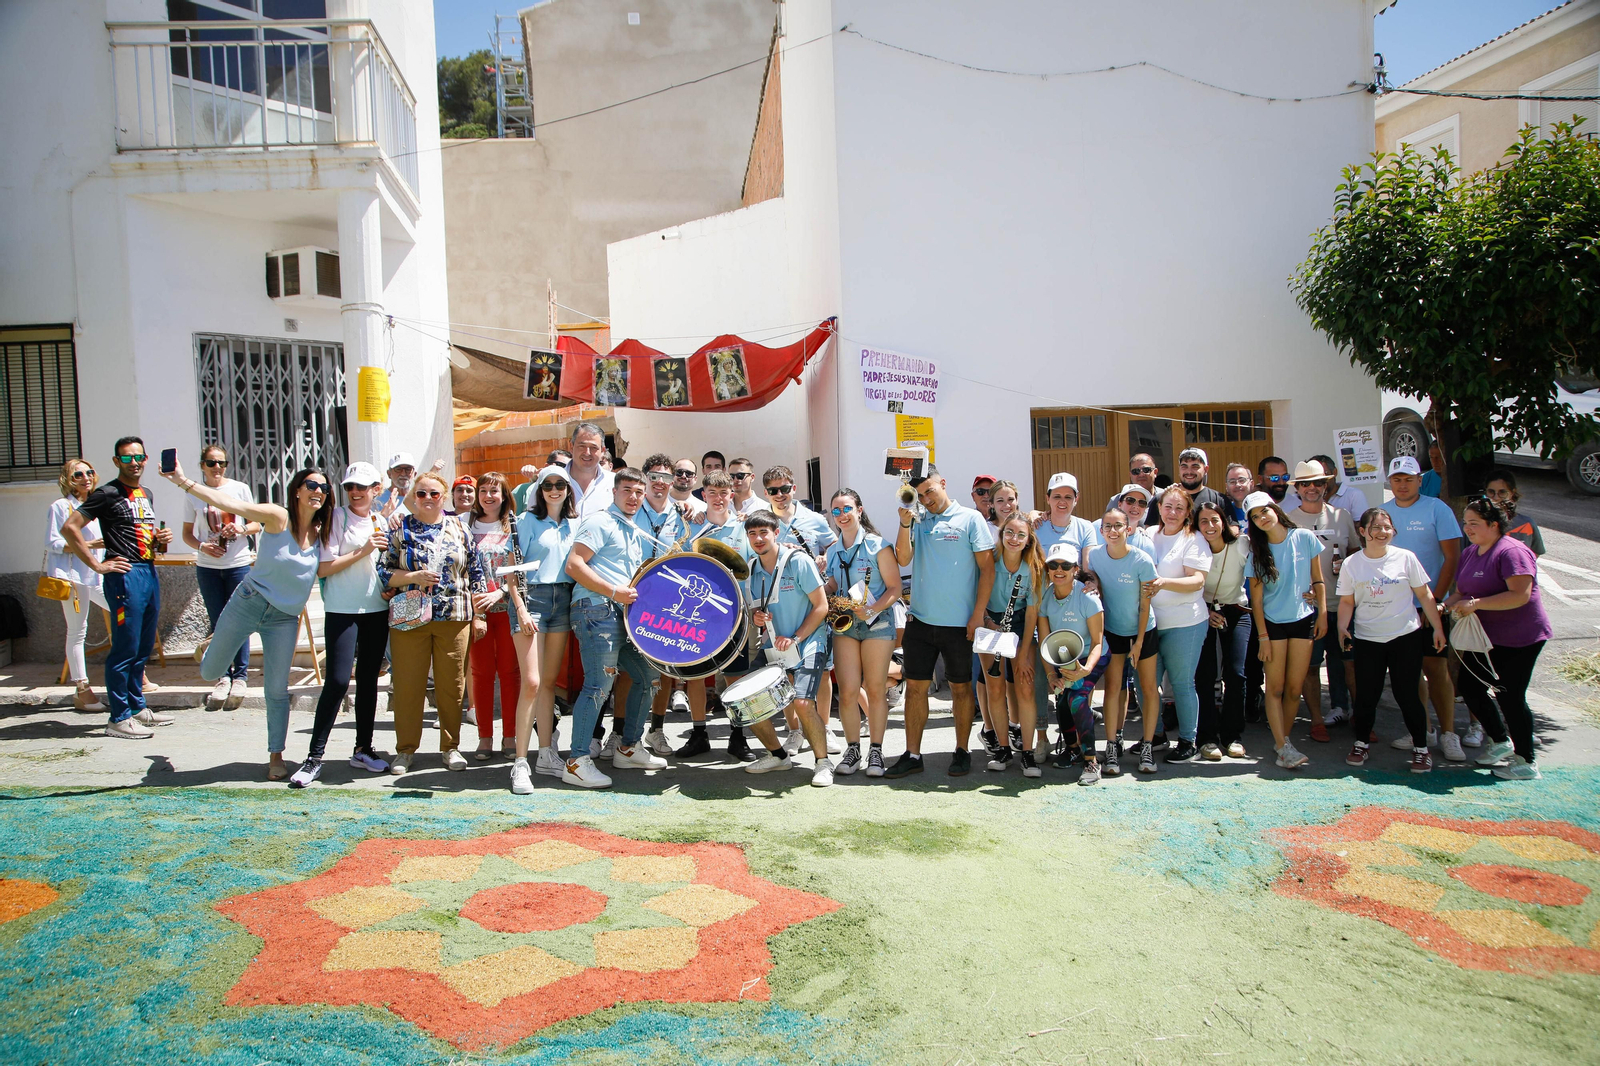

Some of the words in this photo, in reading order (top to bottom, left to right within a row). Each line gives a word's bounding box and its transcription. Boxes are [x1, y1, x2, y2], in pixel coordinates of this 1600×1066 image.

[860, 349, 936, 375] PREHERMANDAD
[903, 389, 936, 403] DOLORES
[635, 626, 677, 647] Charanga
[639, 611, 707, 643] PIJAMAS
